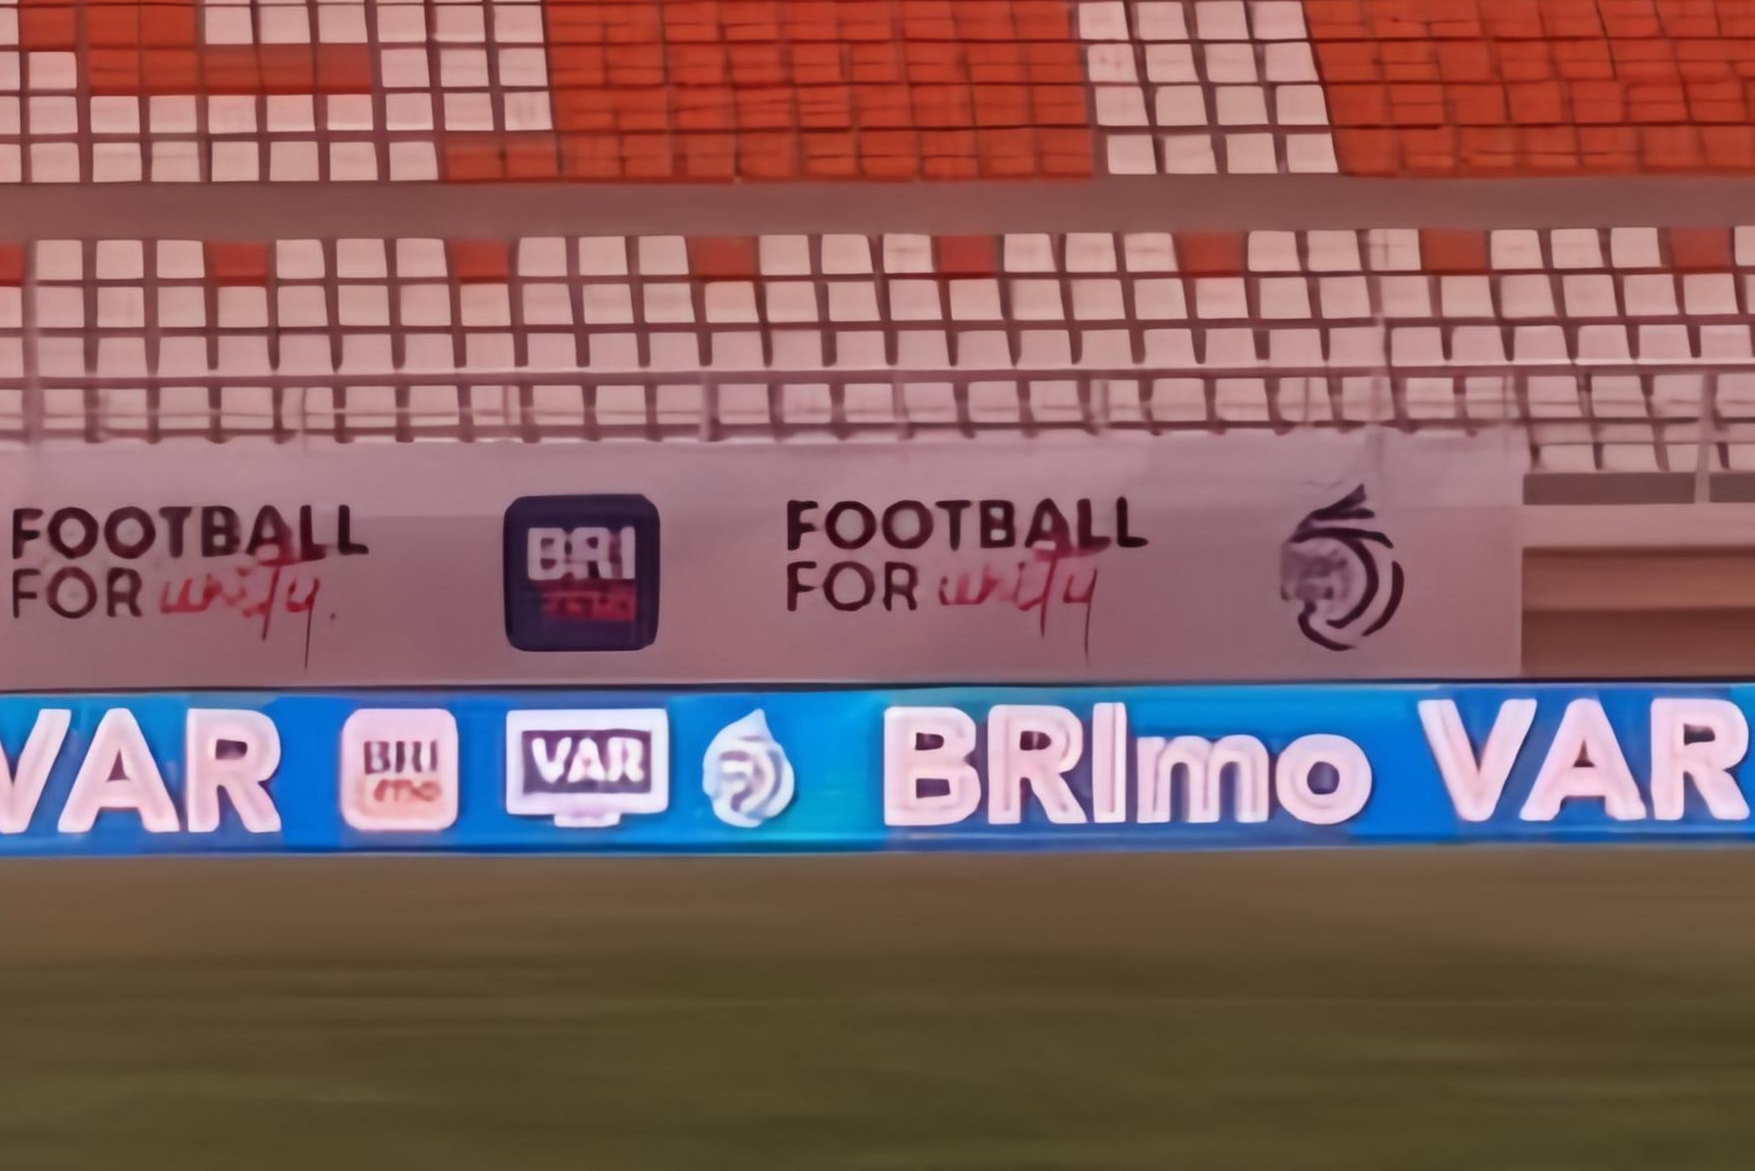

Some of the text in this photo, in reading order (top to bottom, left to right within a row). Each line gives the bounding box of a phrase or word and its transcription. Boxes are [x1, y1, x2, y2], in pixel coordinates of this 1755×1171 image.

[12, 504, 369, 560] FOOTBALL
[787, 497, 1148, 551] FOOTBALL
[527, 526, 636, 580] BRI
[12, 566, 142, 619] FOR
[787, 561, 919, 611] FOR
[531, 736, 644, 783] VAR
[883, 698, 1751, 826] BRImo VAR
